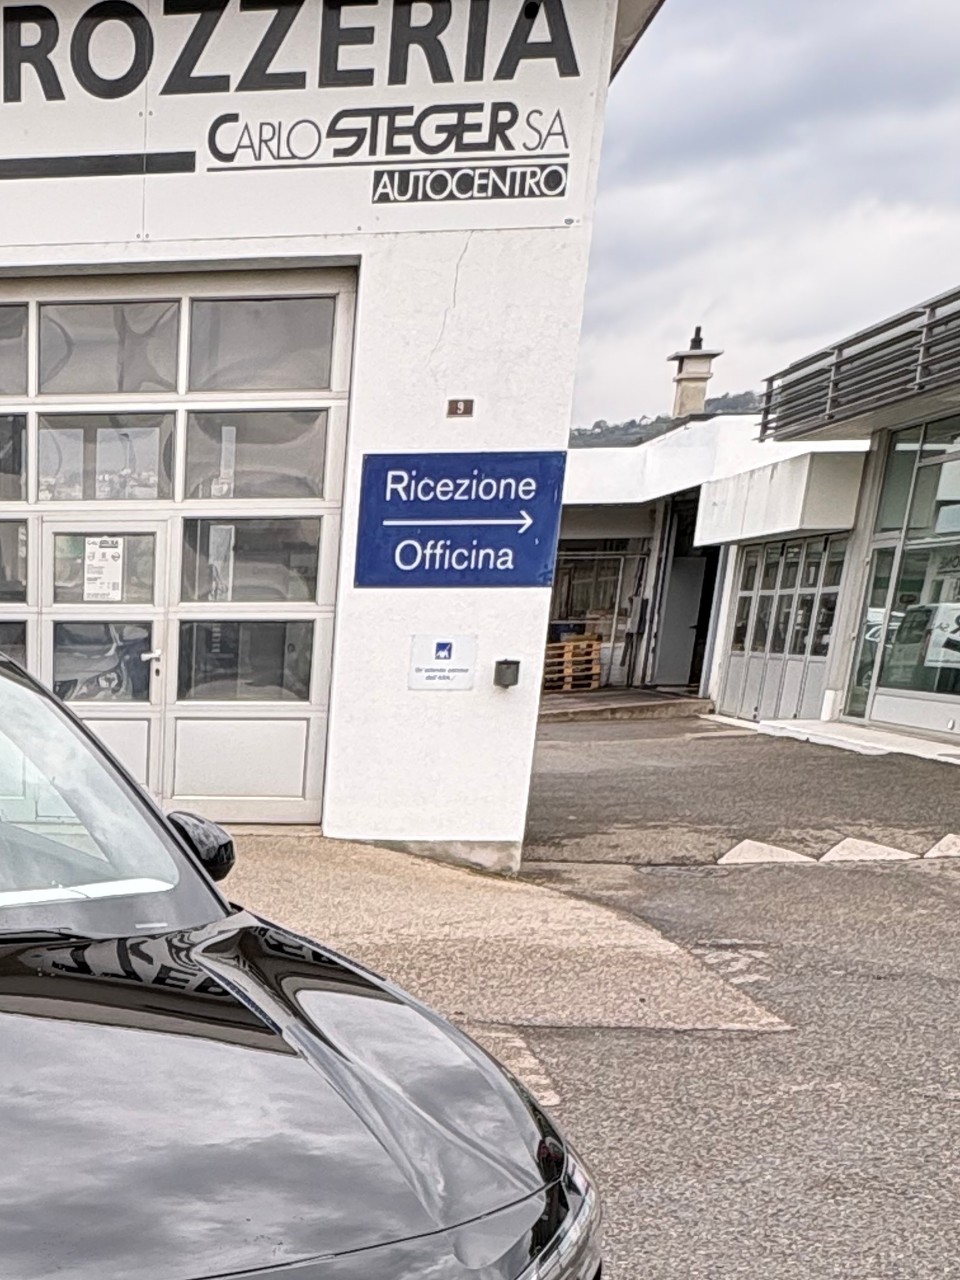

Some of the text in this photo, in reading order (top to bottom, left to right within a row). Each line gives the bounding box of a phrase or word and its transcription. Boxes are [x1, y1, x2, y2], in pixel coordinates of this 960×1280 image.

[208, 101, 569, 163] CARLO STEGER SA
[373, 164, 567, 201] AUTOCENTRO
[456, 401, 465, 414] 9
[385, 469, 537, 501] Ricezione
[394, 539, 515, 571] Officina
